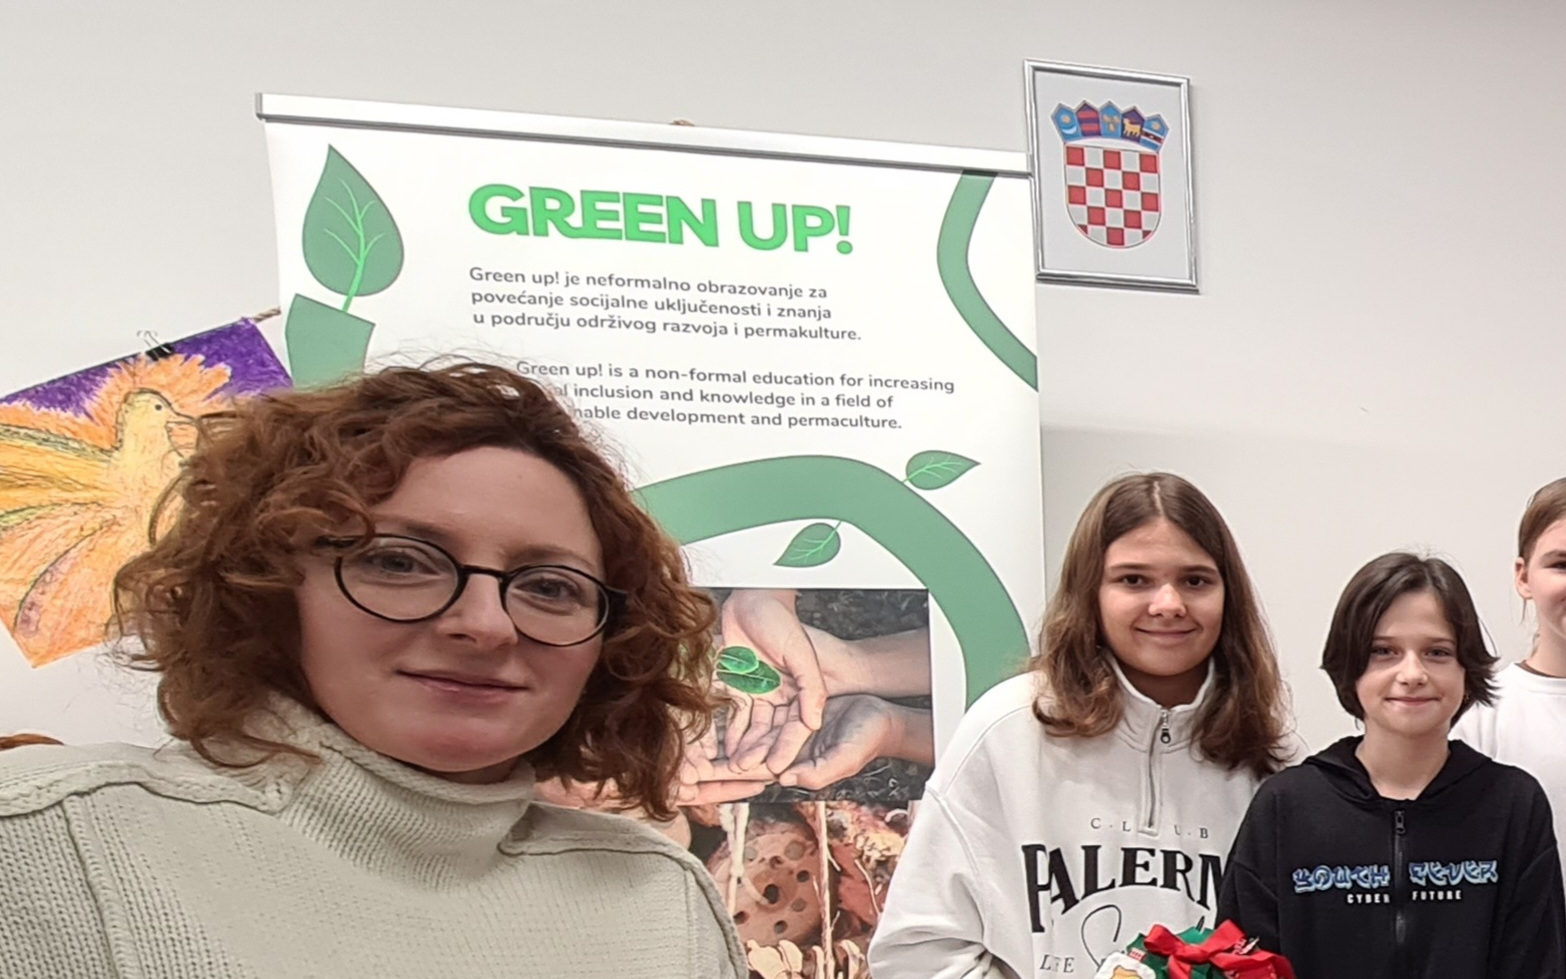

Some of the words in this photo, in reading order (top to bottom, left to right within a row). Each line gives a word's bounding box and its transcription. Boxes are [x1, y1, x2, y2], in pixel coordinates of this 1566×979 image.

[468, 183, 719, 248] GREEN
[737, 201, 854, 255] UP!
[469, 266, 526, 284] Green
[532, 271, 559, 286] up!
[565, 272, 580, 288] je
[586, 274, 691, 293] neformalno
[697, 280, 803, 299] obrazovanje
[808, 287, 828, 299] za
[471, 289, 564, 308] povećanje
[569, 294, 648, 311] socijalne
[654, 298, 761, 317] uključenosti
[766, 303, 772, 317] i
[776, 306, 832, 322] znanja
[473, 314, 485, 325] u
[491, 311, 571, 330] području
[577, 315, 656, 334] održivog
[662, 321, 728, 337] razvoja
[733, 323, 739, 336] i
[744, 324, 862, 341] permakulture.
[516, 361, 569, 376] Green
[575, 363, 602, 379] up!
[609, 363, 623, 377] is
[629, 367, 639, 378] a
[645, 367, 747, 384] non-formal
[752, 371, 835, 387] education
[840, 373, 864, 387] for
[869, 374, 955, 394] increasing
[573, 383, 653, 400] inclusion
[659, 388, 693, 401] and
[700, 389, 796, 408] knowledge
[801, 393, 815, 406] in
[821, 396, 830, 407] a
[835, 394, 871, 408] field
[876, 395, 894, 408] of
[627, 406, 746, 426] development
[751, 413, 782, 426] and
[788, 414, 902, 429] permaculture.
[1412, 890, 1462, 901] FUTURE
